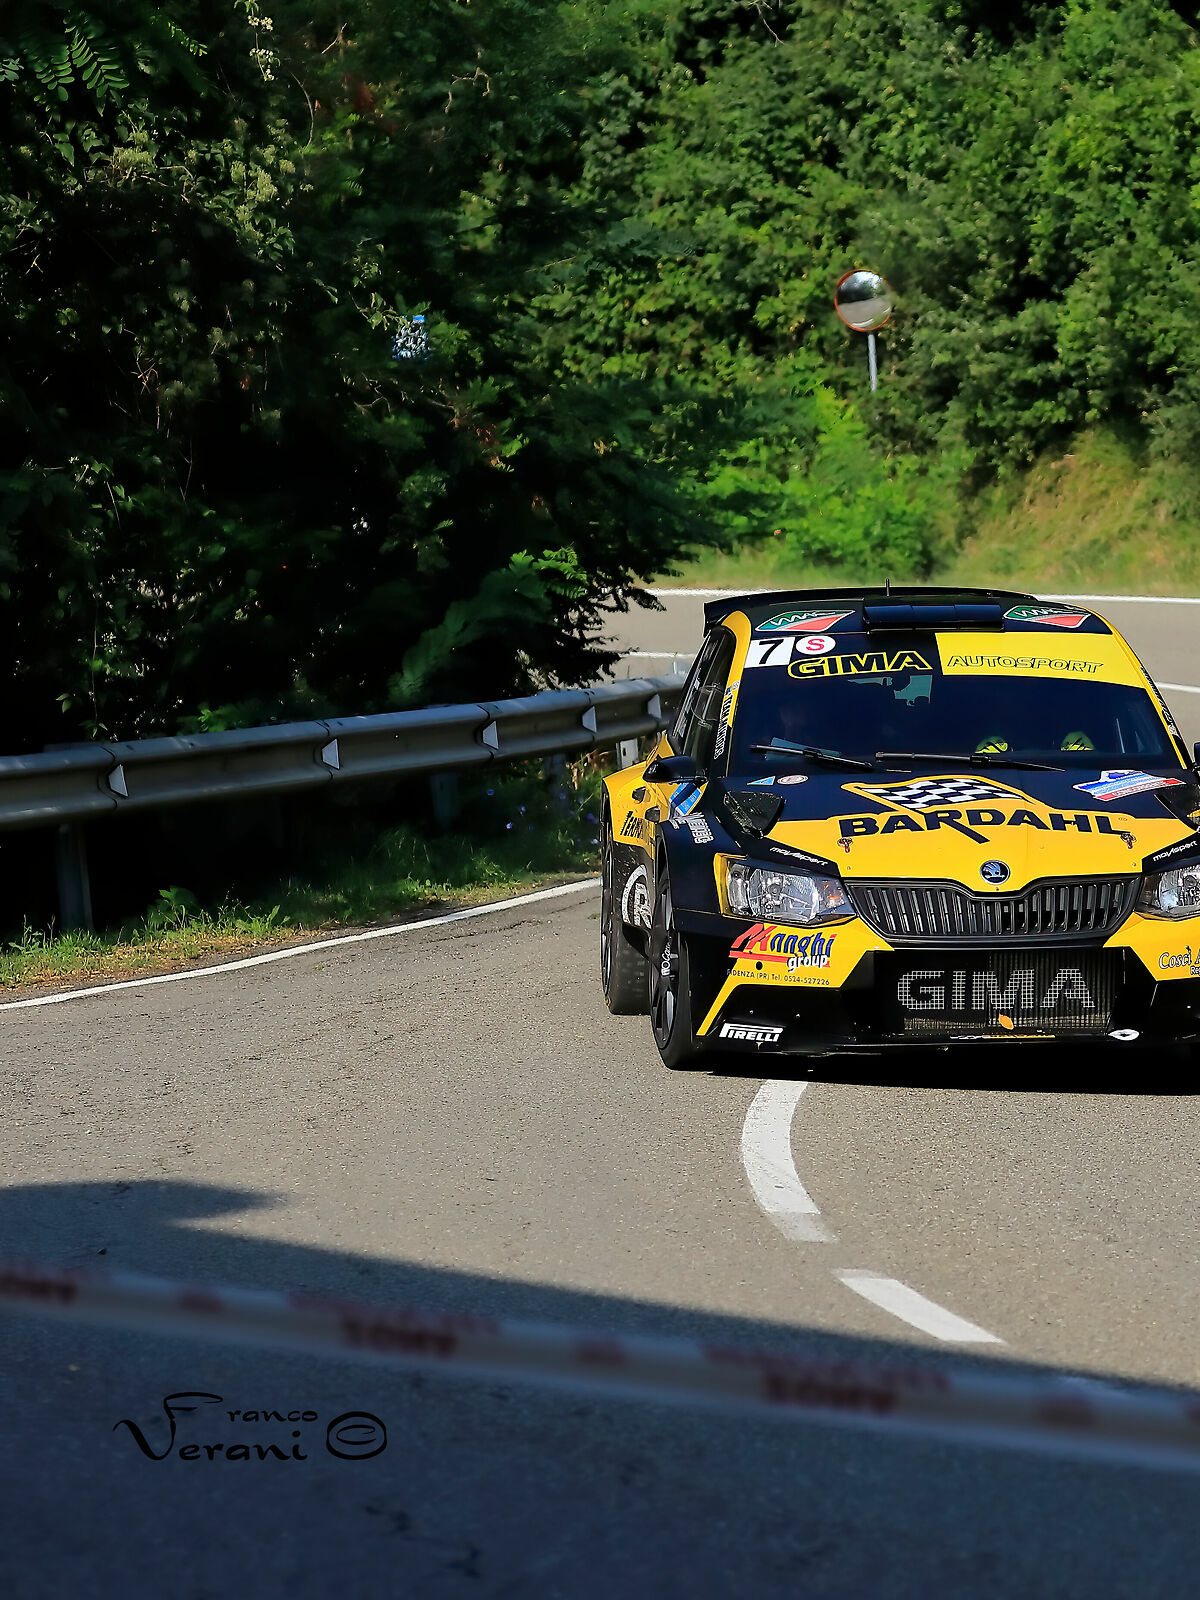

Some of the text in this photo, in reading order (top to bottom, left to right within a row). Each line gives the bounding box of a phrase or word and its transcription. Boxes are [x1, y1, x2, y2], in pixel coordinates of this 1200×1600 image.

[758, 638, 825, 665] 7 S
[787, 651, 1104, 679] GIMA AUTOSPORT
[838, 809, 1132, 844] BARDAHL
[730, 923, 837, 958] Manghi
[726, 969, 755, 978] FIDENZA
[757, 973, 769, 981] (PR)
[784, 975, 830, 986] 0524-527226
[787, 955, 828, 973] group
[897, 968, 1096, 1010] GIMA
[719, 1023, 783, 1042] PIRELLI
